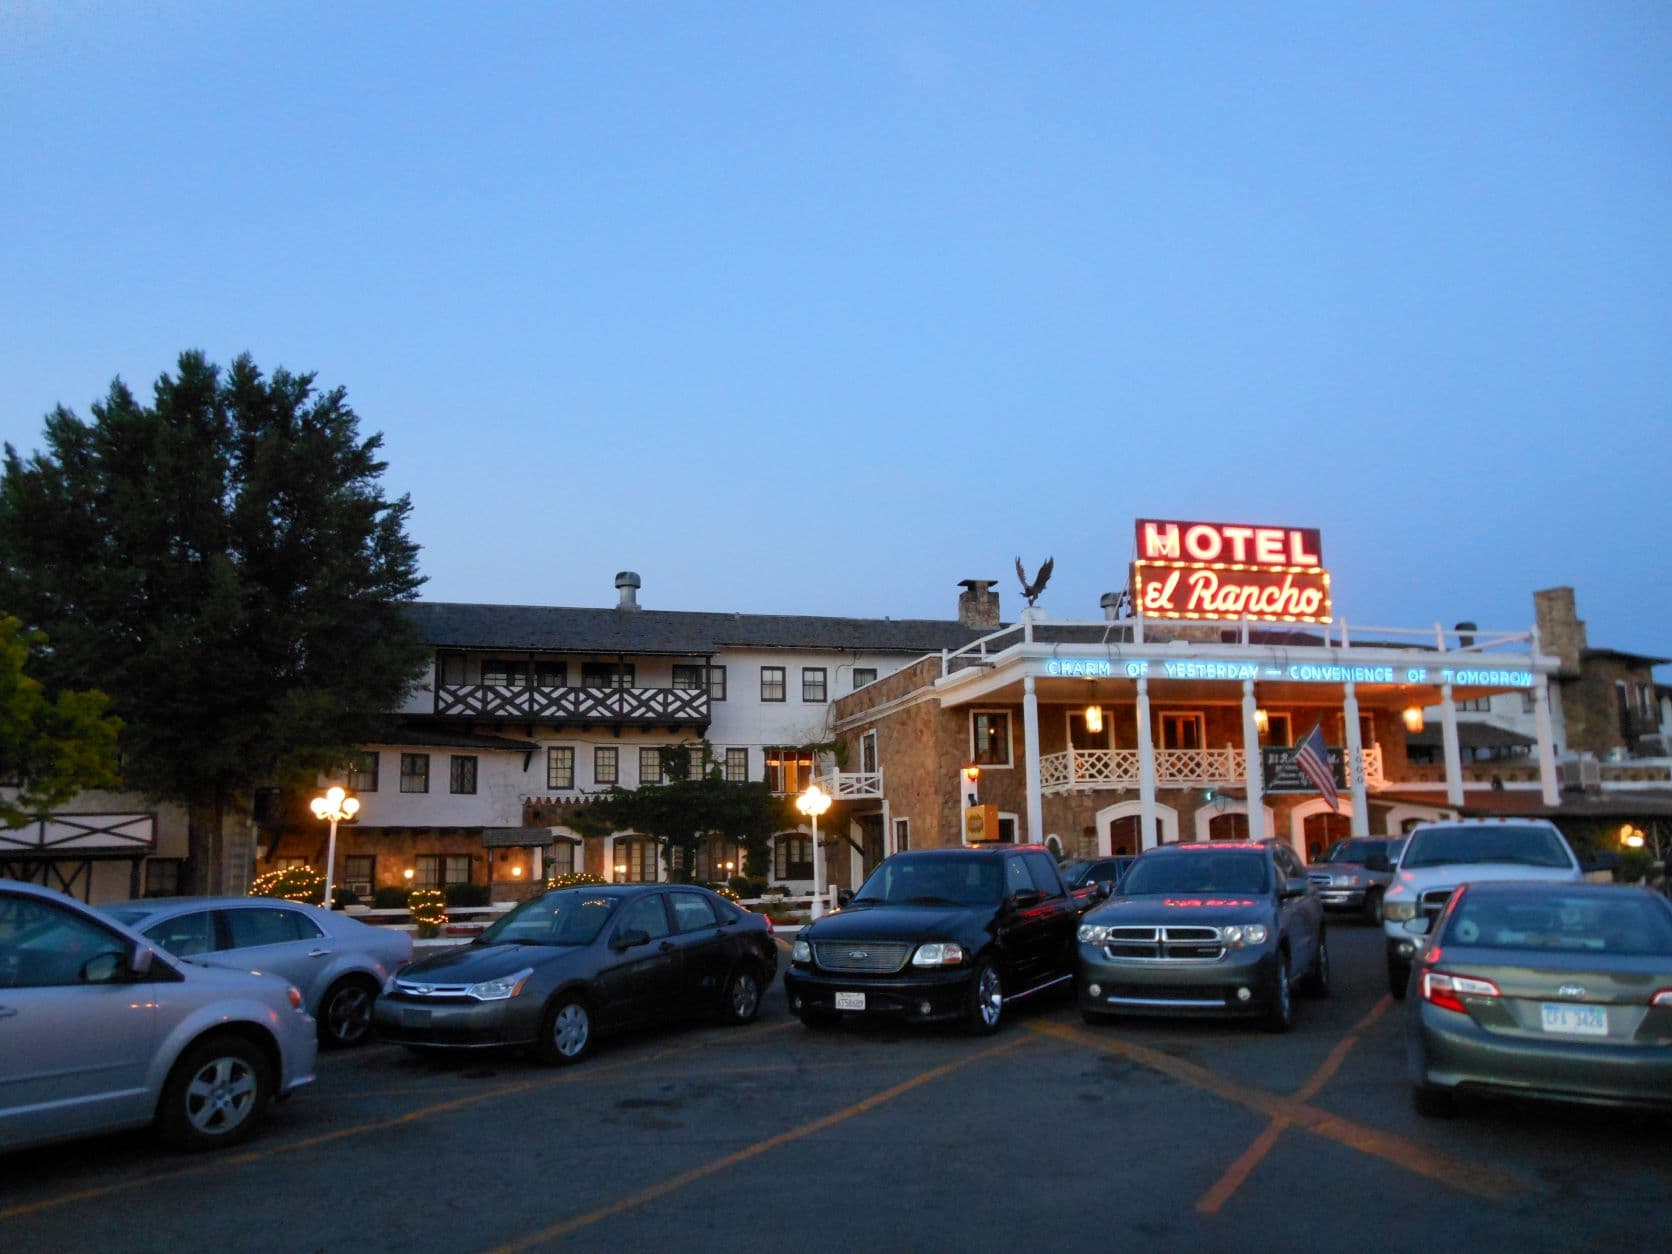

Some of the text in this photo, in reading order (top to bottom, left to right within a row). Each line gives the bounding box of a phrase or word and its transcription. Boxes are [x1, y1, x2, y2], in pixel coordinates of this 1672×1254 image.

[1144, 522, 1318, 565] MOTEL
[1187, 570, 1323, 614] Rancho
[1047, 661, 1110, 678] CHARM
[1125, 662, 1149, 678] OF
[1164, 663, 1259, 679] YESTERDAY
[1289, 665, 1393, 682] CONVENIENCE
[1408, 669, 1426, 682] OF
[1443, 670, 1533, 686] TOMORROW
